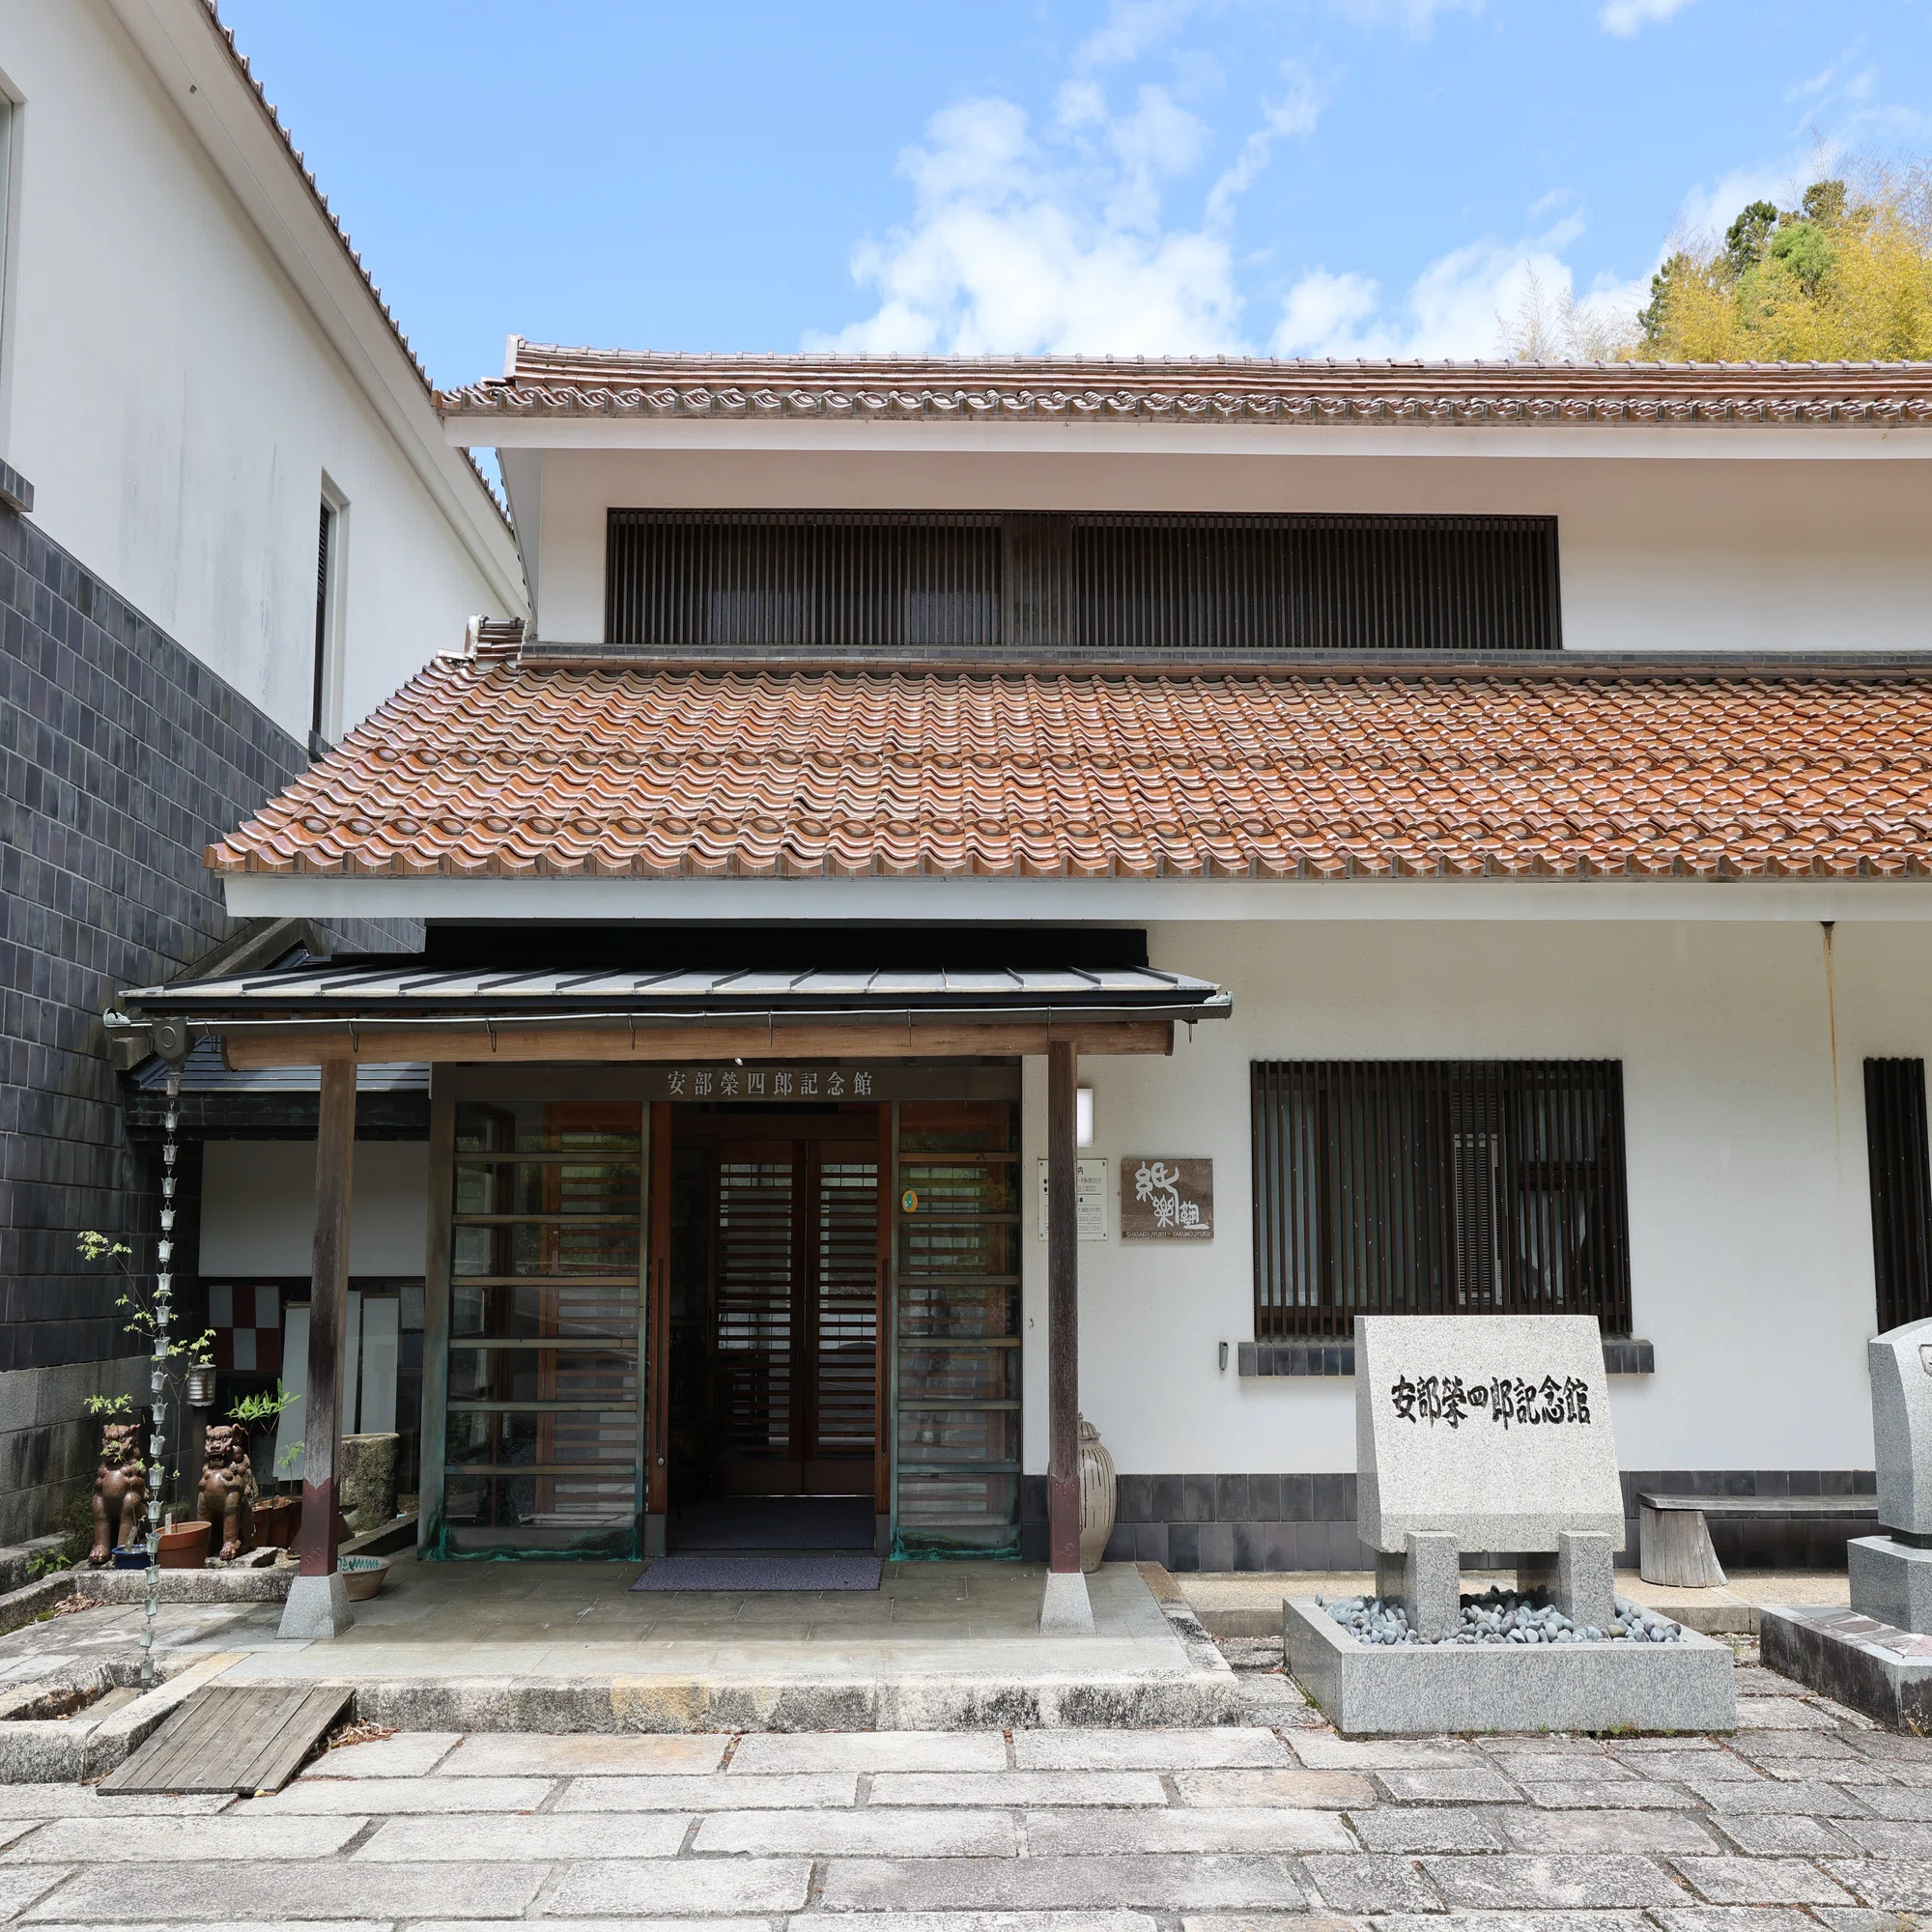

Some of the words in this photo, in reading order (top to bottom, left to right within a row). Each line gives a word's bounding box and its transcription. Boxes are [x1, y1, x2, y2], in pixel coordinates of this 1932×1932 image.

[668, 1070, 872, 1096] 安部榮四郎記念館
[1391, 1374, 1591, 1431] 安部榮四郎記念館
